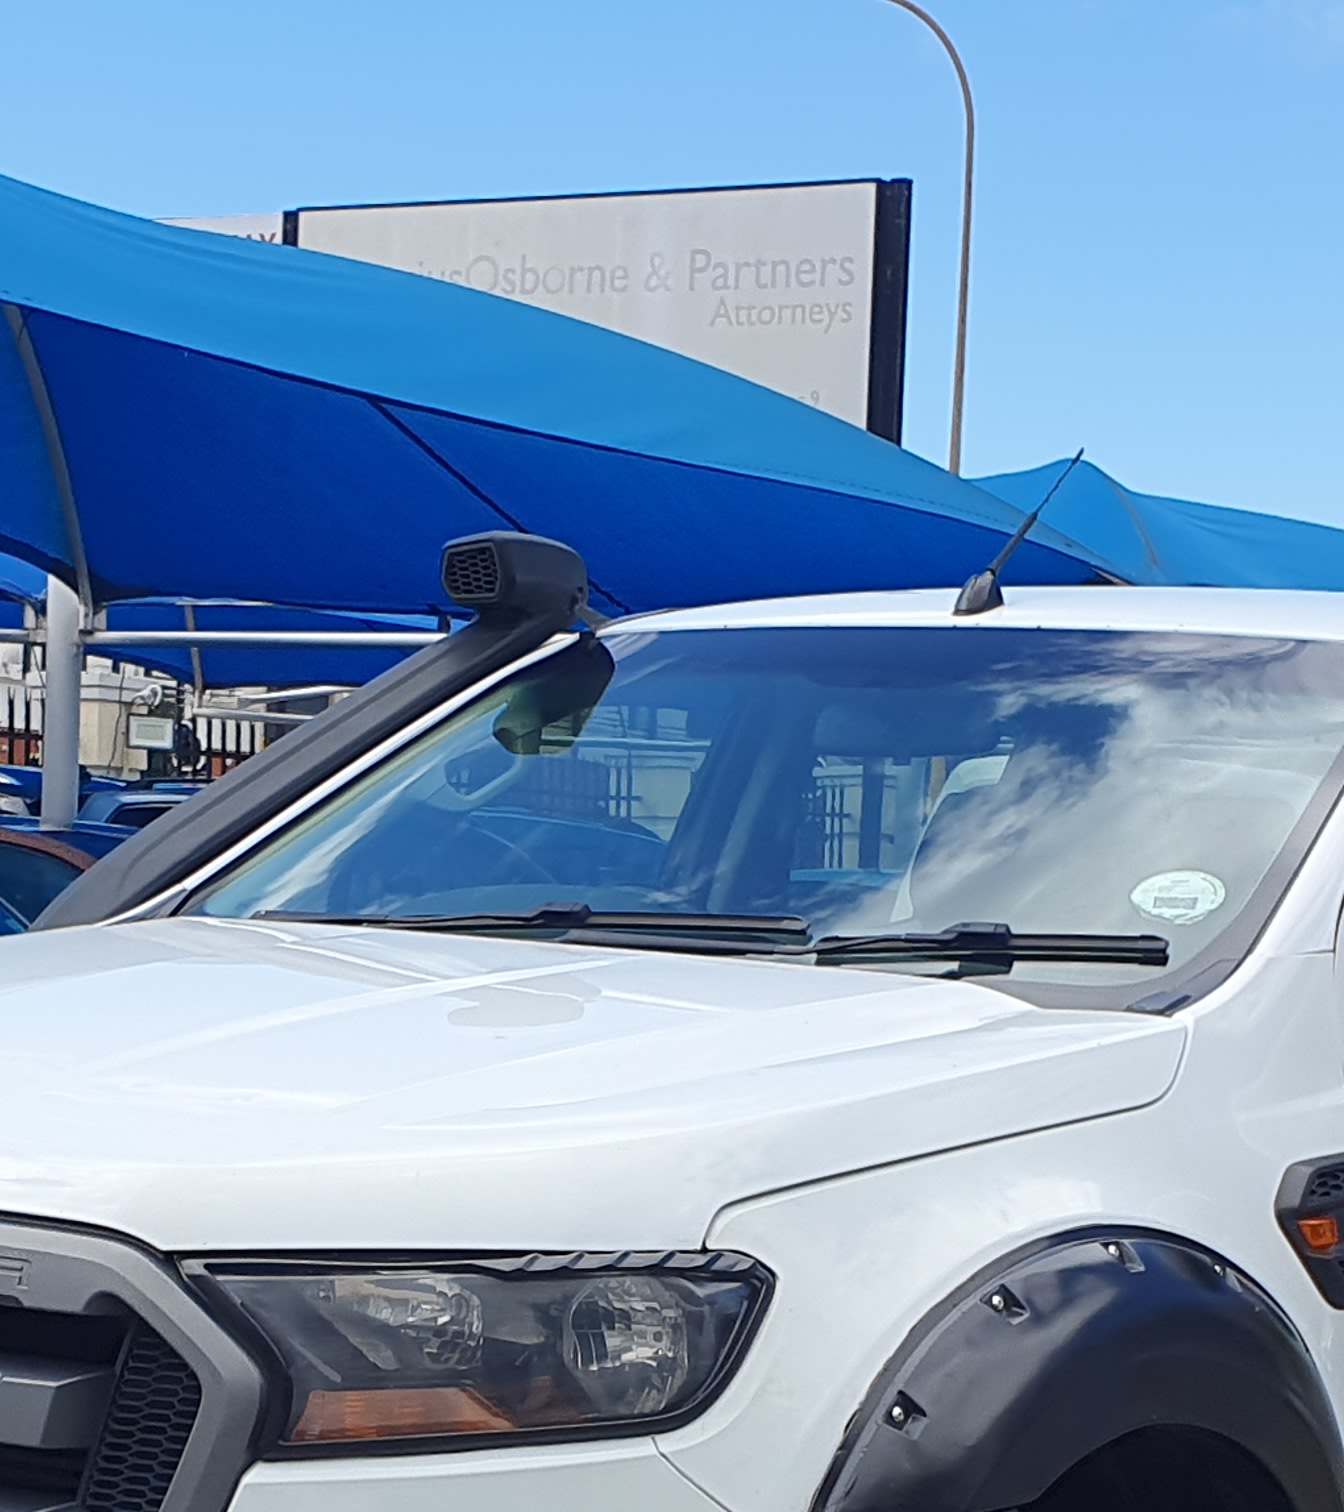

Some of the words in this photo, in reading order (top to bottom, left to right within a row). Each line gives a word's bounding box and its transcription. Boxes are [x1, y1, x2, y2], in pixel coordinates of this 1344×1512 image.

[644, 252, 672, 293] &
[688, 249, 855, 292] Partners
[709, 296, 853, 334] Attorneys
